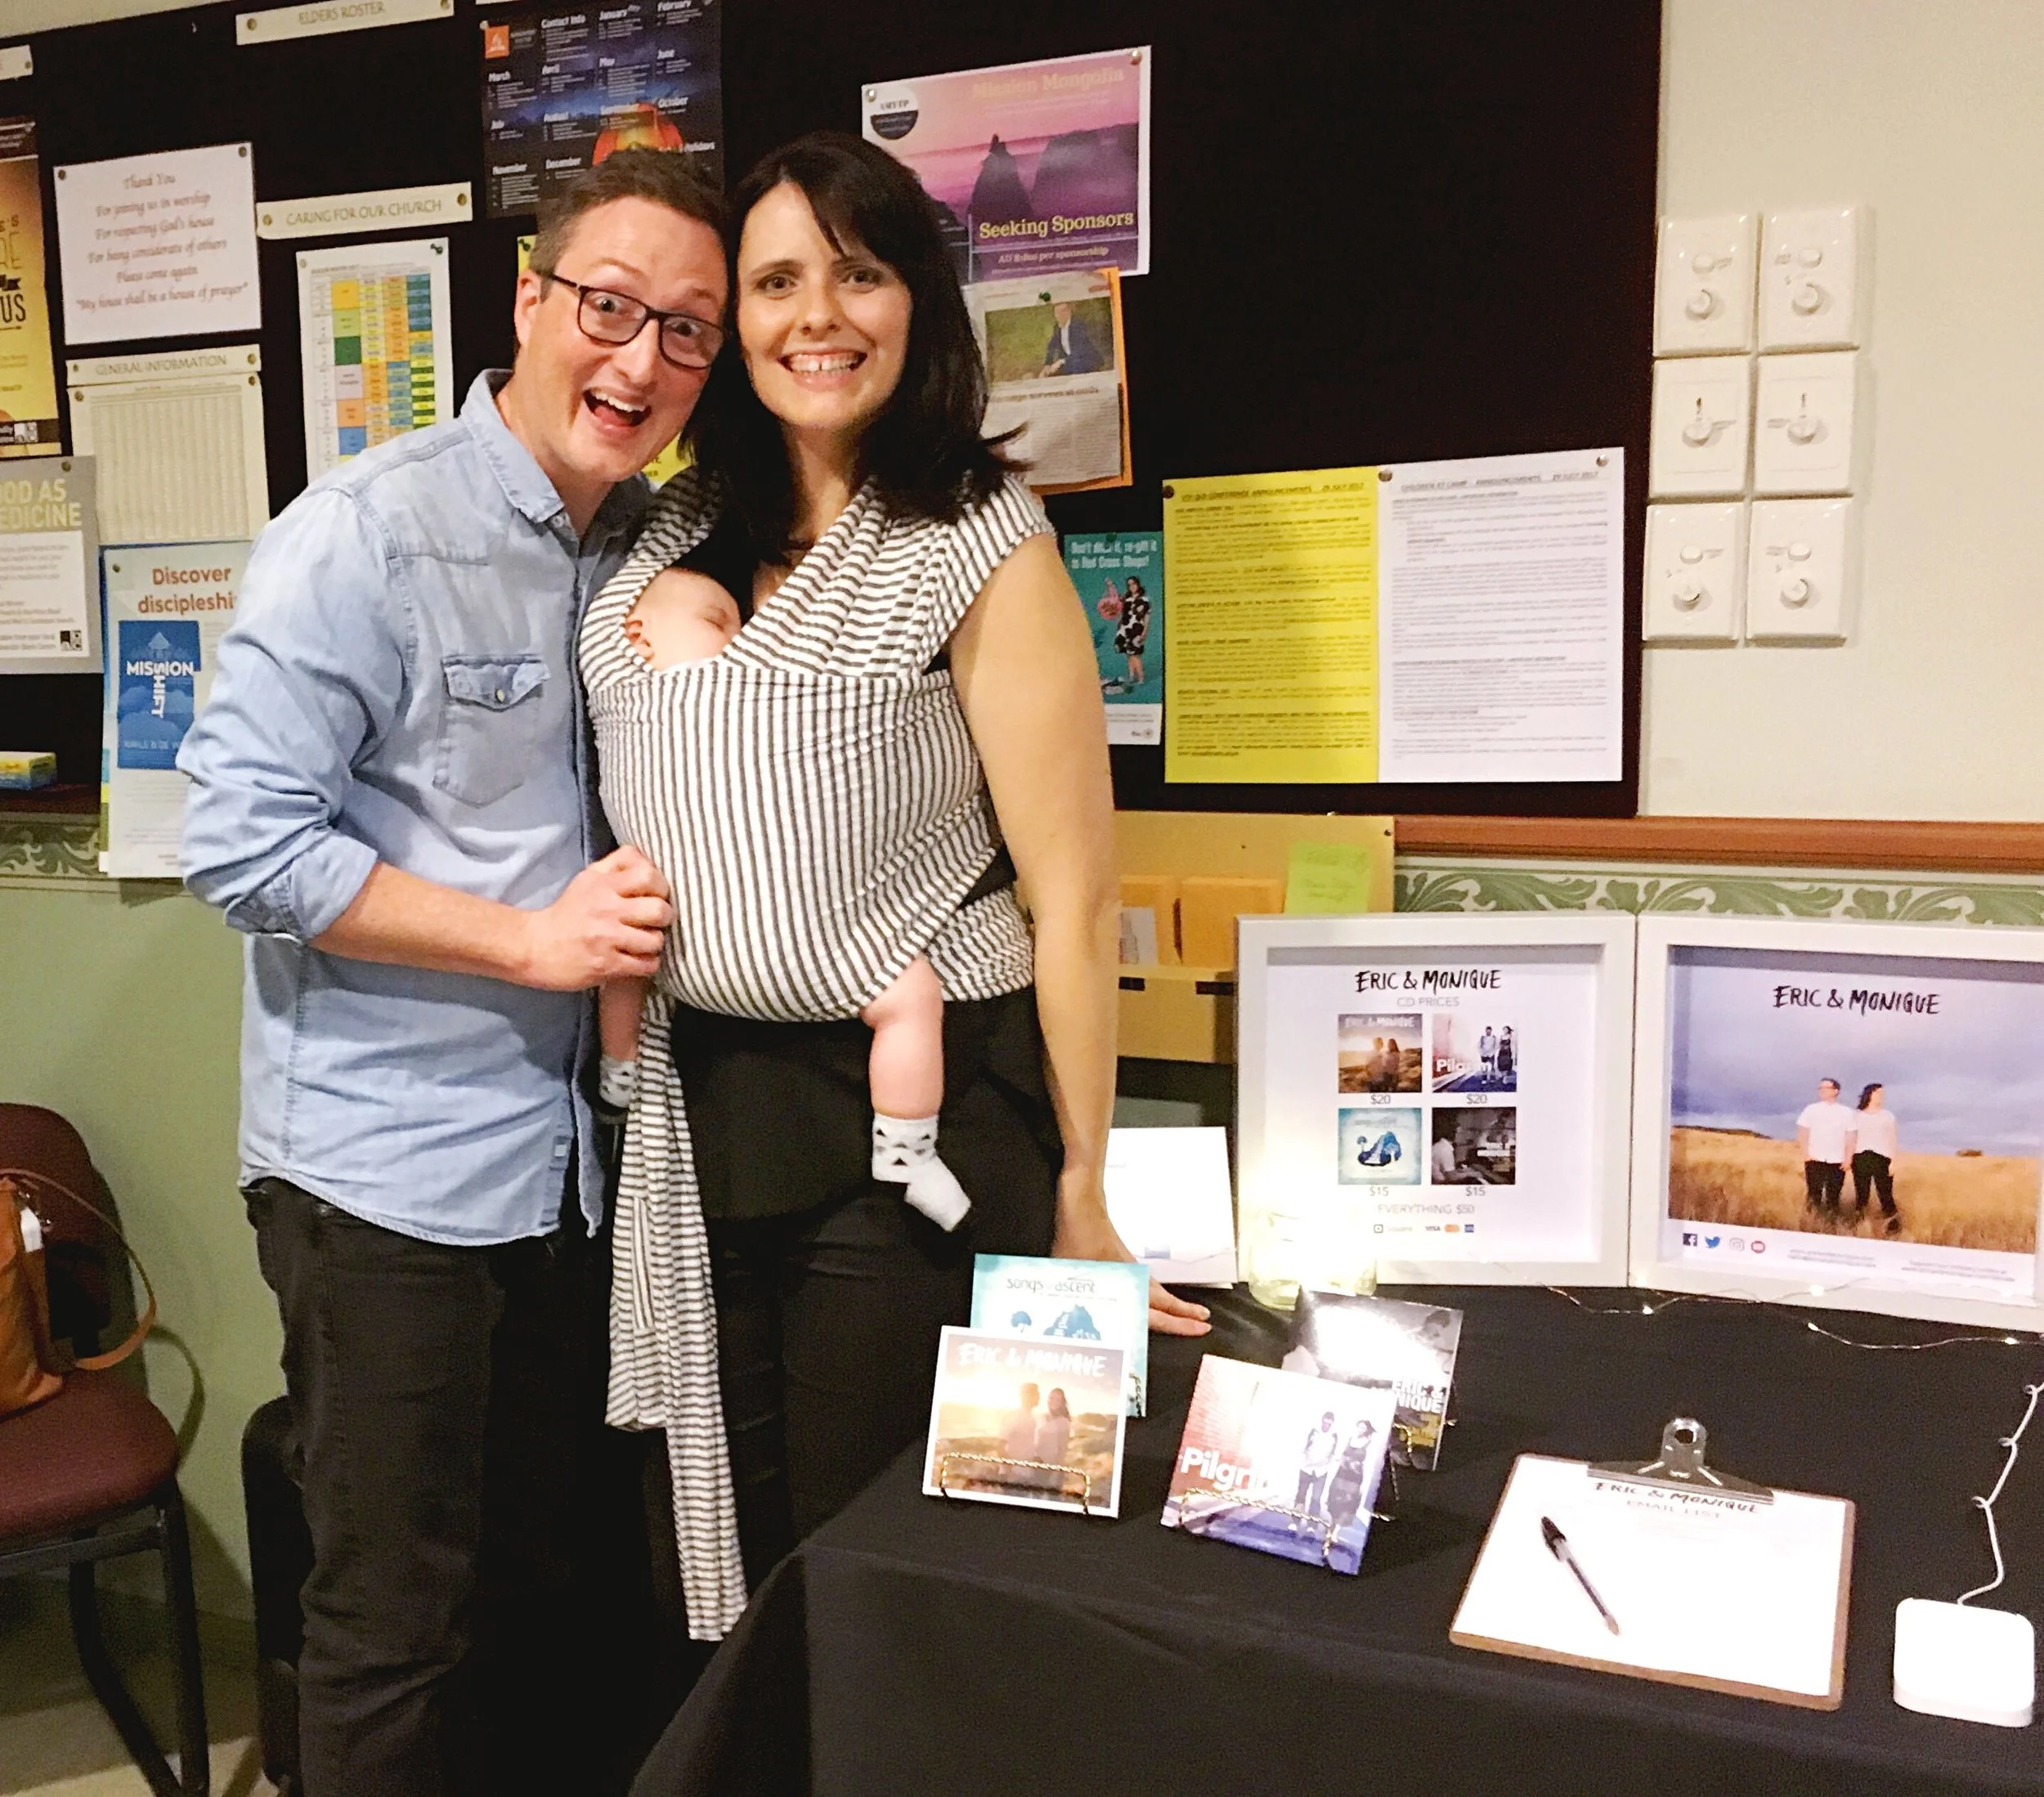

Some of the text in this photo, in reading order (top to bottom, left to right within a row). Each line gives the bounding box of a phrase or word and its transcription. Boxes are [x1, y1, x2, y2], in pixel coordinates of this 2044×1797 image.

[298, 2, 384, 25] ELDERS ROSTER
[156, 173, 177, 186] You
[173, 190, 211, 208] worship
[286, 199, 442, 226] CARING FOR OUR CHURCH
[979, 212, 1135, 239] Seeking Sponsors
[95, 354, 228, 376] GENERAL INFORMATION
[0, 478, 67, 504] OD AS
[152, 567, 232, 586] Discover
[137, 591, 237, 616] discipleshi
[1354, 969, 1503, 995] ERIC & MONIQUE
[1396, 996, 1460, 1007] CD PRICES
[1773, 985, 1942, 1017] ERIC & MONIQUE
[1370, 1094, 1392, 1105] $20
[1466, 1093, 1488, 1105] $20
[1369, 1186, 1389, 1197] $15
[1465, 1185, 1486, 1197] $15
[1378, 1203, 1453, 1215] EVERYTHING
[957, 1342, 1005, 1367] ERIC
[1395, 1392, 1442, 1414] NIQUE
[1594, 1481, 1760, 1515] ERIC & MONIQUE
